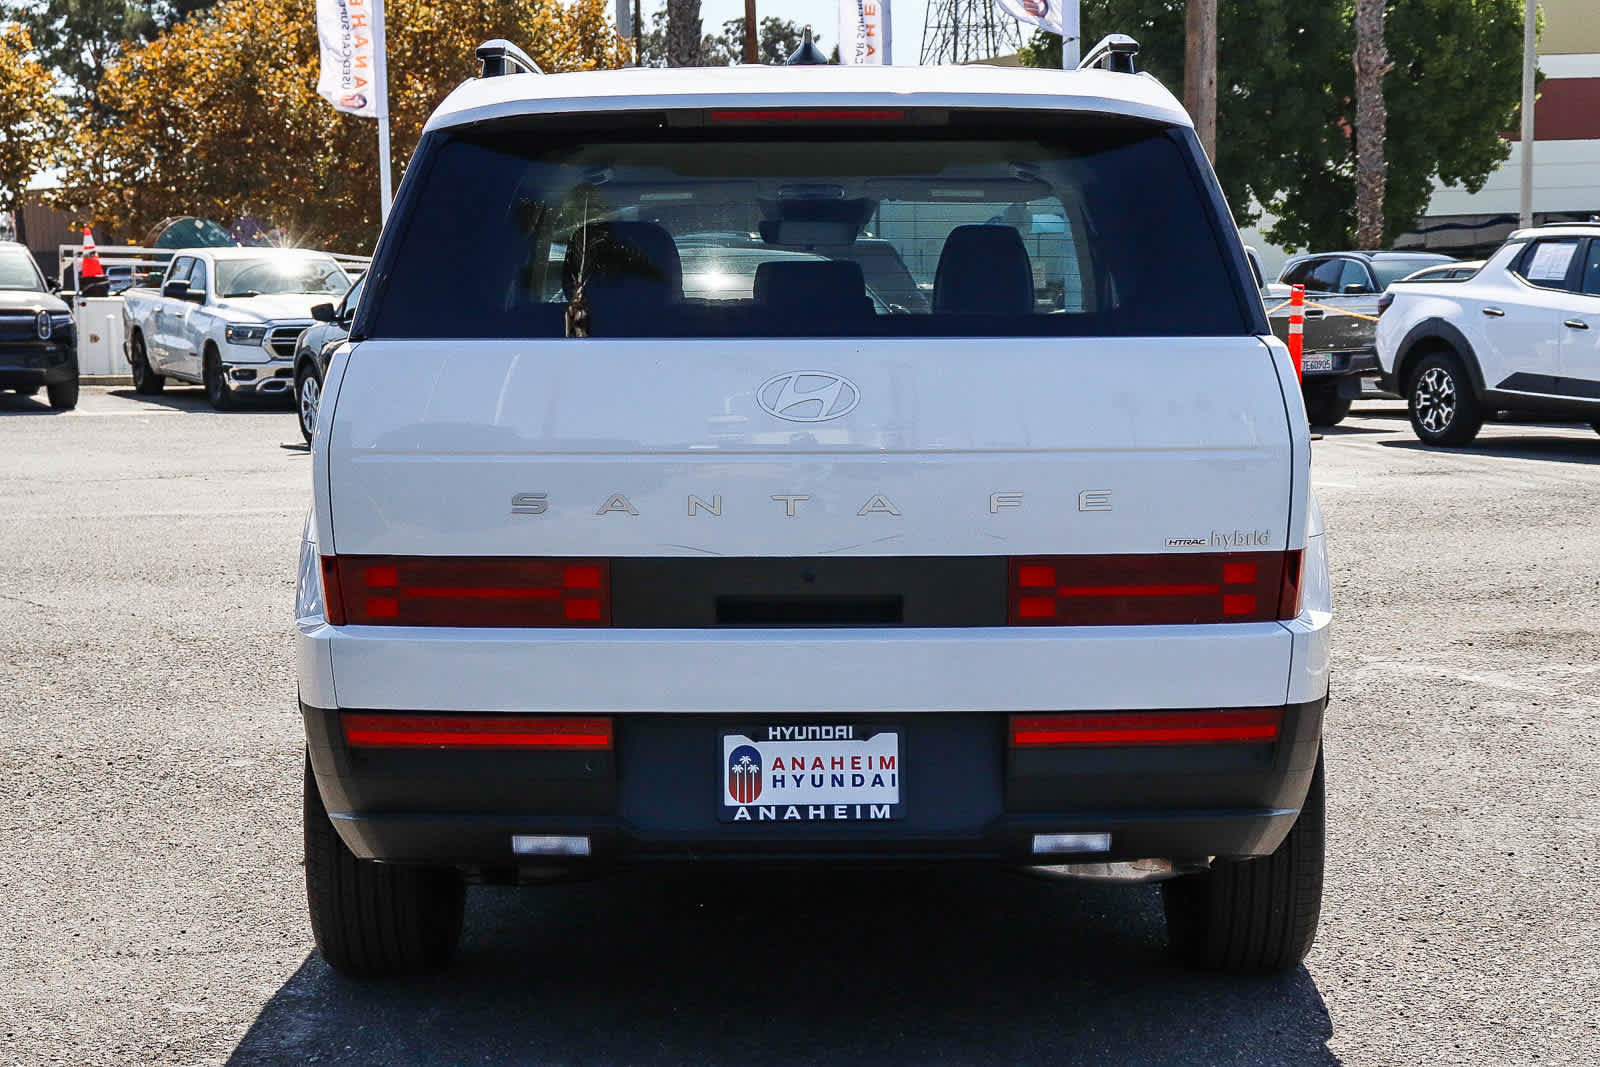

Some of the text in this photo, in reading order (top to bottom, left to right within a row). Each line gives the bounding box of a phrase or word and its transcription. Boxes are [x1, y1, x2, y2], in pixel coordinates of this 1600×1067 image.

[510, 489, 1113, 517] SANTA FE
[1168, 529, 1271, 549] HTRAC hybrid
[768, 725, 853, 740] HYUNDAI
[772, 755, 896, 771] ANAHEIM
[772, 773, 896, 789] HYUNDAI
[734, 805, 891, 821] ANAHEIM
